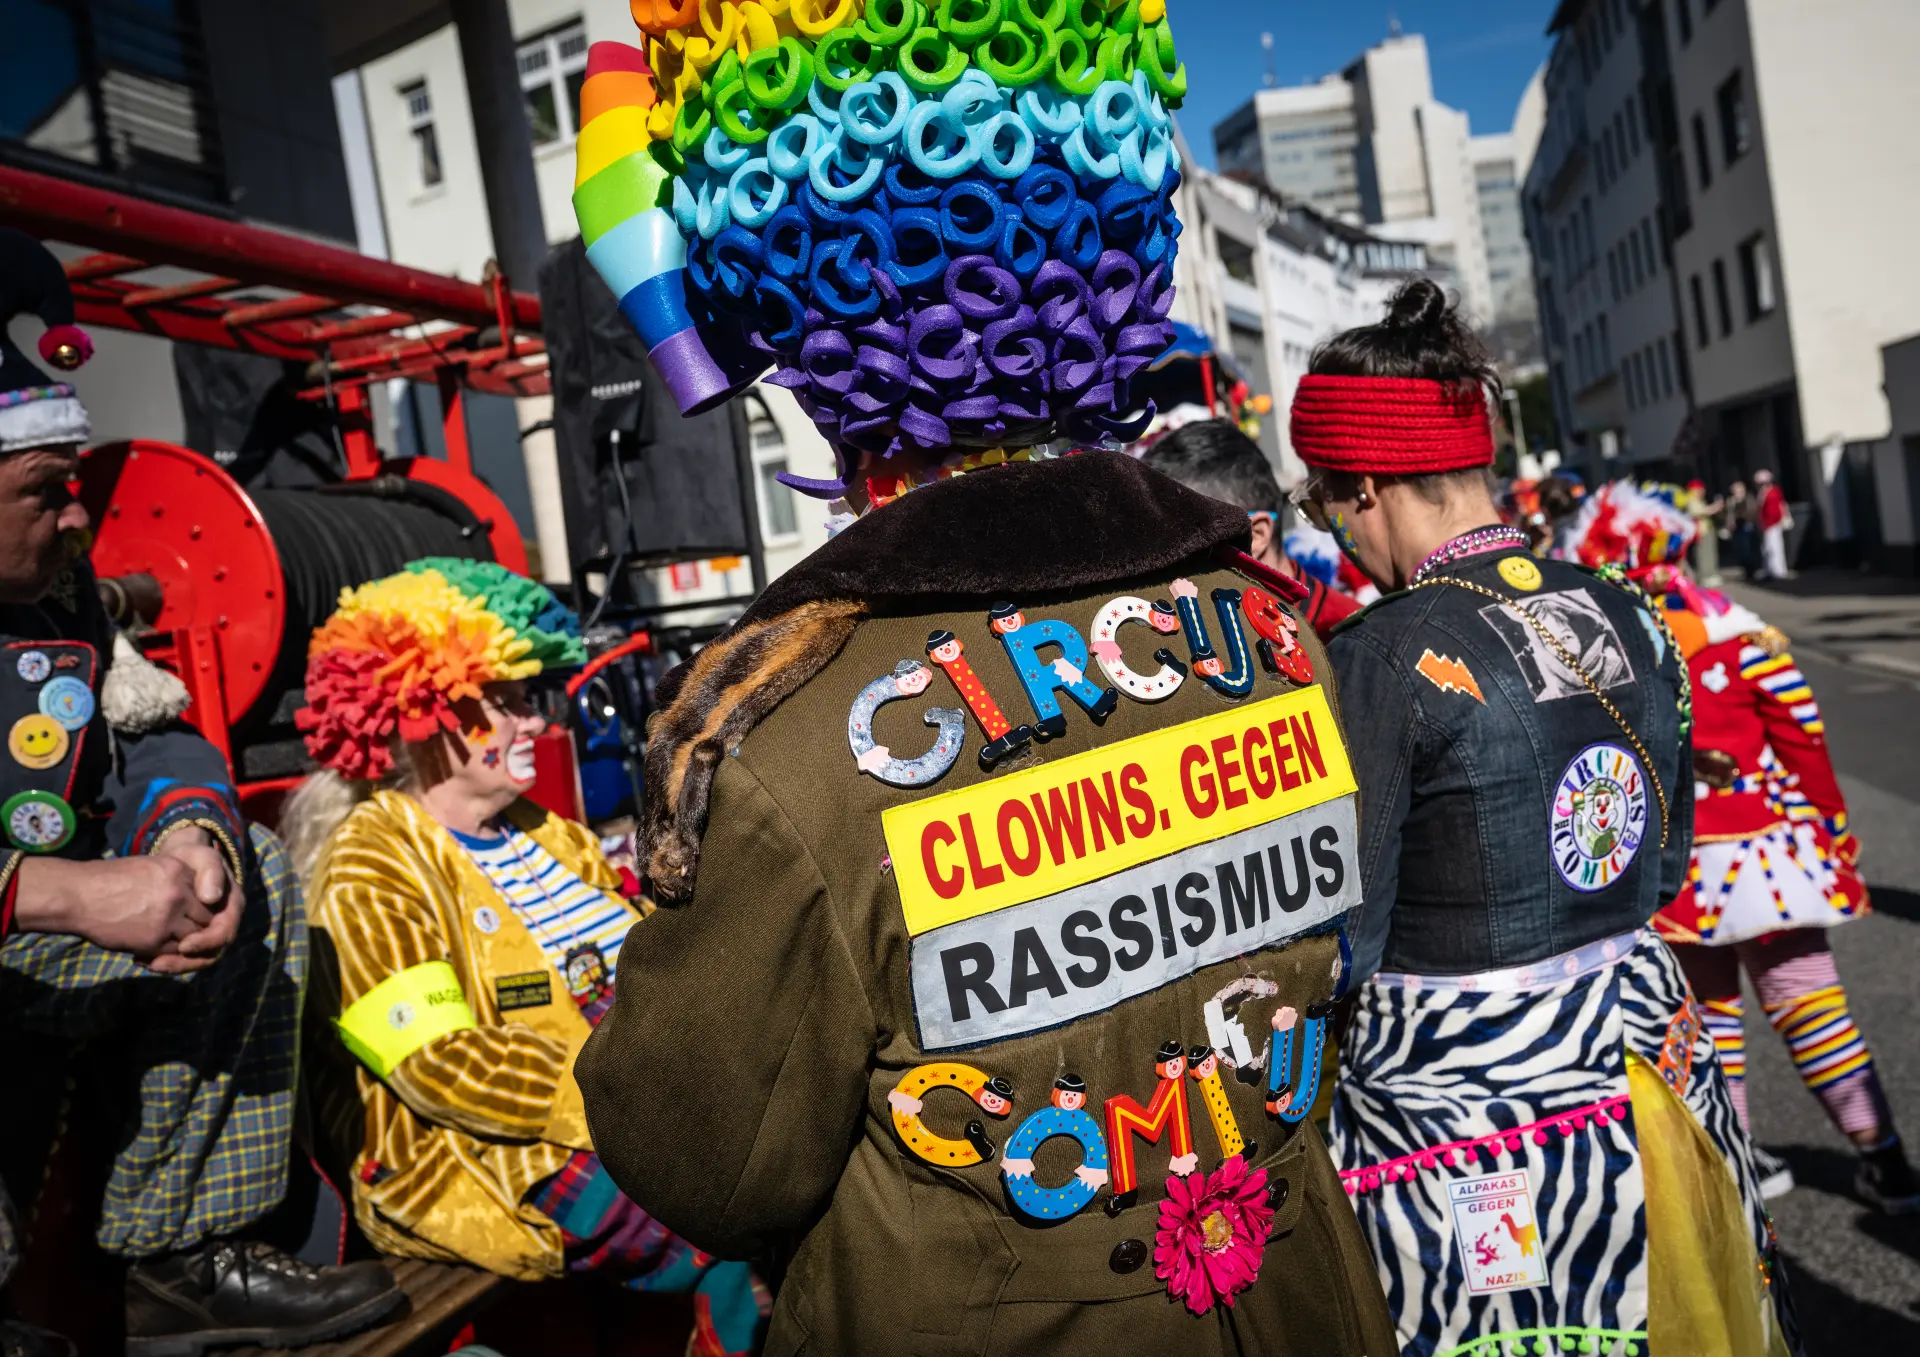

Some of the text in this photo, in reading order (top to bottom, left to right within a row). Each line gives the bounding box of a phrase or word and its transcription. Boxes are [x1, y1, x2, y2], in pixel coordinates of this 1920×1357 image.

[848, 578, 1314, 788] CIRCUS
[920, 711, 1328, 900] CLOWNS. GEGEN
[1556, 748, 1640, 818] CIRCUS
[940, 825, 1346, 1023] RASSISMUS
[1458, 1178, 1517, 1195] ALPAKAS
[1468, 1198, 1516, 1213] GEGEN
[1486, 1272, 1527, 1286] NAZIS
